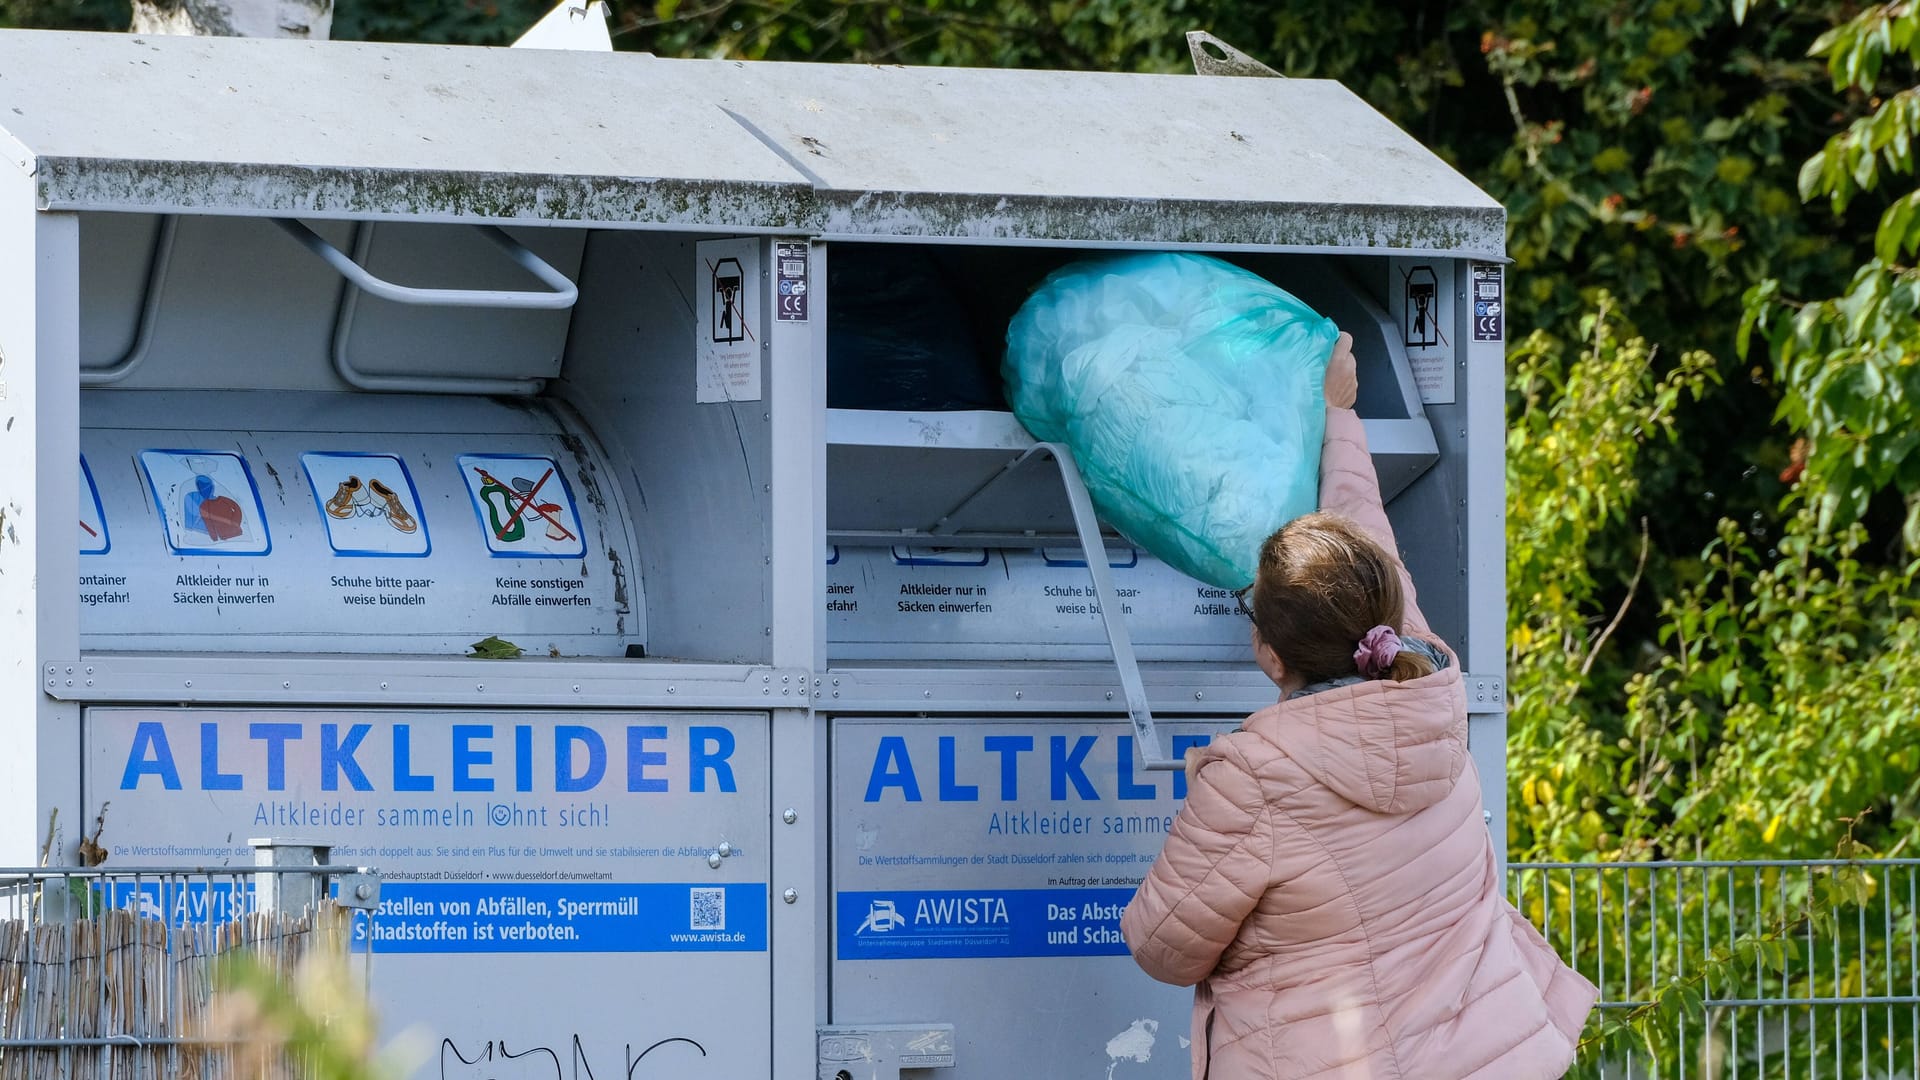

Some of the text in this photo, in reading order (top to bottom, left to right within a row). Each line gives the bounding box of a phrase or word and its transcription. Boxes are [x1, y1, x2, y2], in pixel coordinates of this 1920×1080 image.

[176, 575, 269, 588] Altkleider nur in
[331, 576, 435, 592] Schuhe bitte paar-
[496, 578, 584, 592] Keine sonstigen
[900, 583, 987, 596] Altkleider nur in
[1044, 585, 1082, 598] Schuhe
[1197, 588, 1226, 599] Keine
[173, 592, 275, 605] Säcken einwerfen
[343, 593, 425, 606] weise bündeln
[491, 595, 591, 606] Abfälle einwerfen
[898, 600, 992, 614] Säcken einwerfen
[1056, 604, 1086, 615] weise
[1194, 604, 1230, 616] Abfälle
[120, 722, 738, 792] ALTKLEIDER
[254, 801, 366, 827] Altkleider
[376, 803, 474, 827] sammeln
[558, 804, 610, 829] sich!
[988, 810, 1178, 835] Altkleider samme
[114, 846, 128, 856] Die
[132, 845, 231, 858] Wertstoffsammlungen
[235, 845, 249, 856] der
[360, 846, 376, 857] sich
[380, 847, 413, 859] doppelt
[416, 849, 432, 857] aus:
[437, 847, 448, 857] Sie
[452, 847, 469, 857] sind
[472, 847, 486, 857] ein
[488, 846, 506, 857] Plus
[508, 847, 520, 857] für
[523, 847, 536, 857] die
[539, 847, 573, 857] Umwelt
[576, 847, 593, 857] und
[595, 847, 608, 857] sie
[610, 847, 659, 857] stabilisieren
[662, 847, 675, 857] die
[859, 855, 872, 866] Die
[875, 854, 967, 867] Wertstoffsammlungen
[971, 854, 984, 865] der
[987, 854, 1007, 865] Stadt
[1011, 853, 1055, 864] Düsseldorf
[1057, 853, 1084, 863] zahlen
[1087, 853, 1102, 863] sich
[1105, 853, 1136, 866] doppelt
[380, 871, 612, 882] andeshauptstadt Düsseldorf www.duesseldorf.de/umweltamt
[1047, 877, 1057, 886] Im
[1059, 877, 1085, 887] Auftrag
[1087, 876, 1099, 885] der
[175, 891, 256, 918] AWIST
[439, 902, 471, 916] von
[476, 897, 551, 919] Abfällen,
[557, 897, 639, 920] Sperrmüll
[914, 898, 1009, 925] AWISTA
[1047, 903, 1076, 920] Das
[356, 922, 579, 941] Shadstoffen ist verboten.
[670, 931, 746, 943] www.awista.de
[1047, 926, 1077, 944] und
